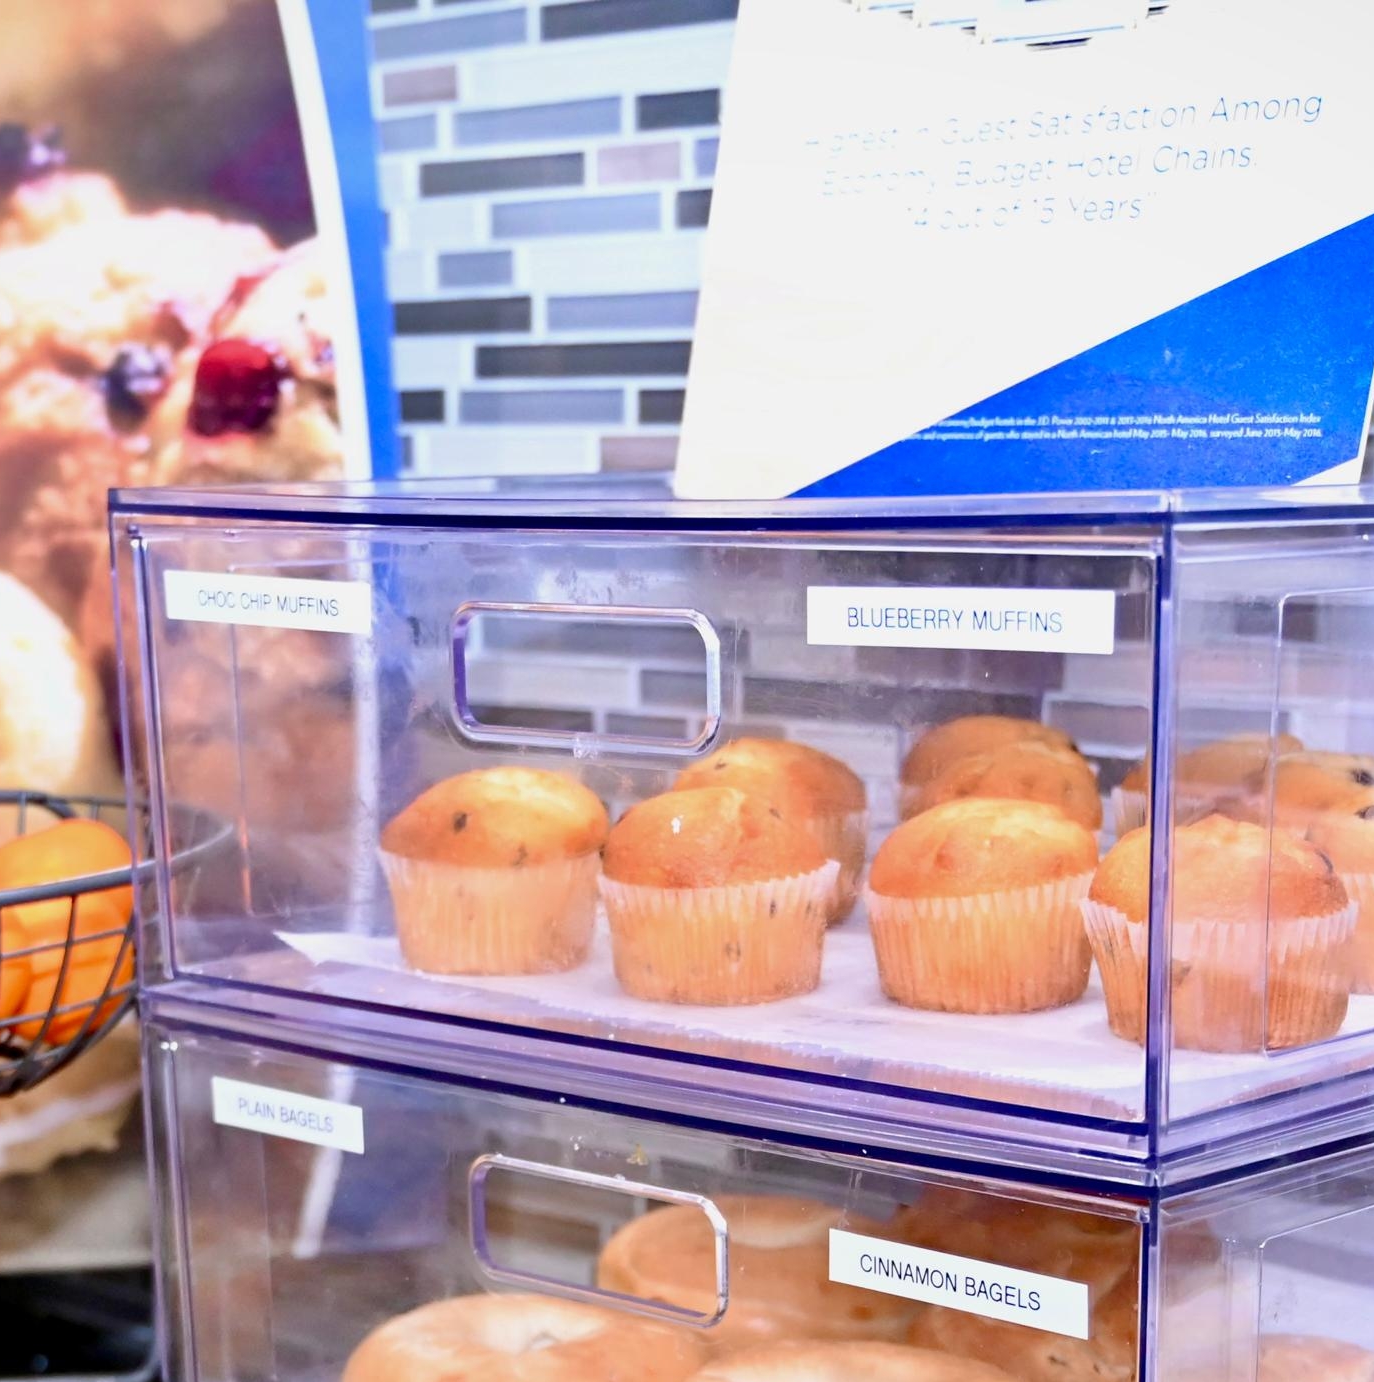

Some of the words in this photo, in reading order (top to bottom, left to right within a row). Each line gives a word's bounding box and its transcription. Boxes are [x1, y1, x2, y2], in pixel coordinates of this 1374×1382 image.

[1209, 96, 1322, 123] Among
[1153, 414, 1175, 425] North
[1208, 413, 1230, 424] Hotel
[1231, 413, 1254, 424] Guest
[1255, 412, 1299, 424] Satisfaction
[1299, 412, 1322, 424] Index
[1133, 428, 1150, 440] May
[1171, 428, 1188, 440] May
[1210, 427, 1244, 440] surveyed
[1244, 427, 1262, 438] June
[198, 589, 236, 610] CHOC
[240, 591, 273, 612] CHIP
[276, 594, 340, 618] MUFFINS
[847, 606, 964, 630] BLUEBERRY
[972, 609, 1064, 633] MUFFINS
[238, 1096, 275, 1121] PLAIN
[280, 1106, 334, 1133] BAGELS
[859, 1253, 958, 1293] CINNAMON
[965, 1276, 1042, 1312] BAGELS
